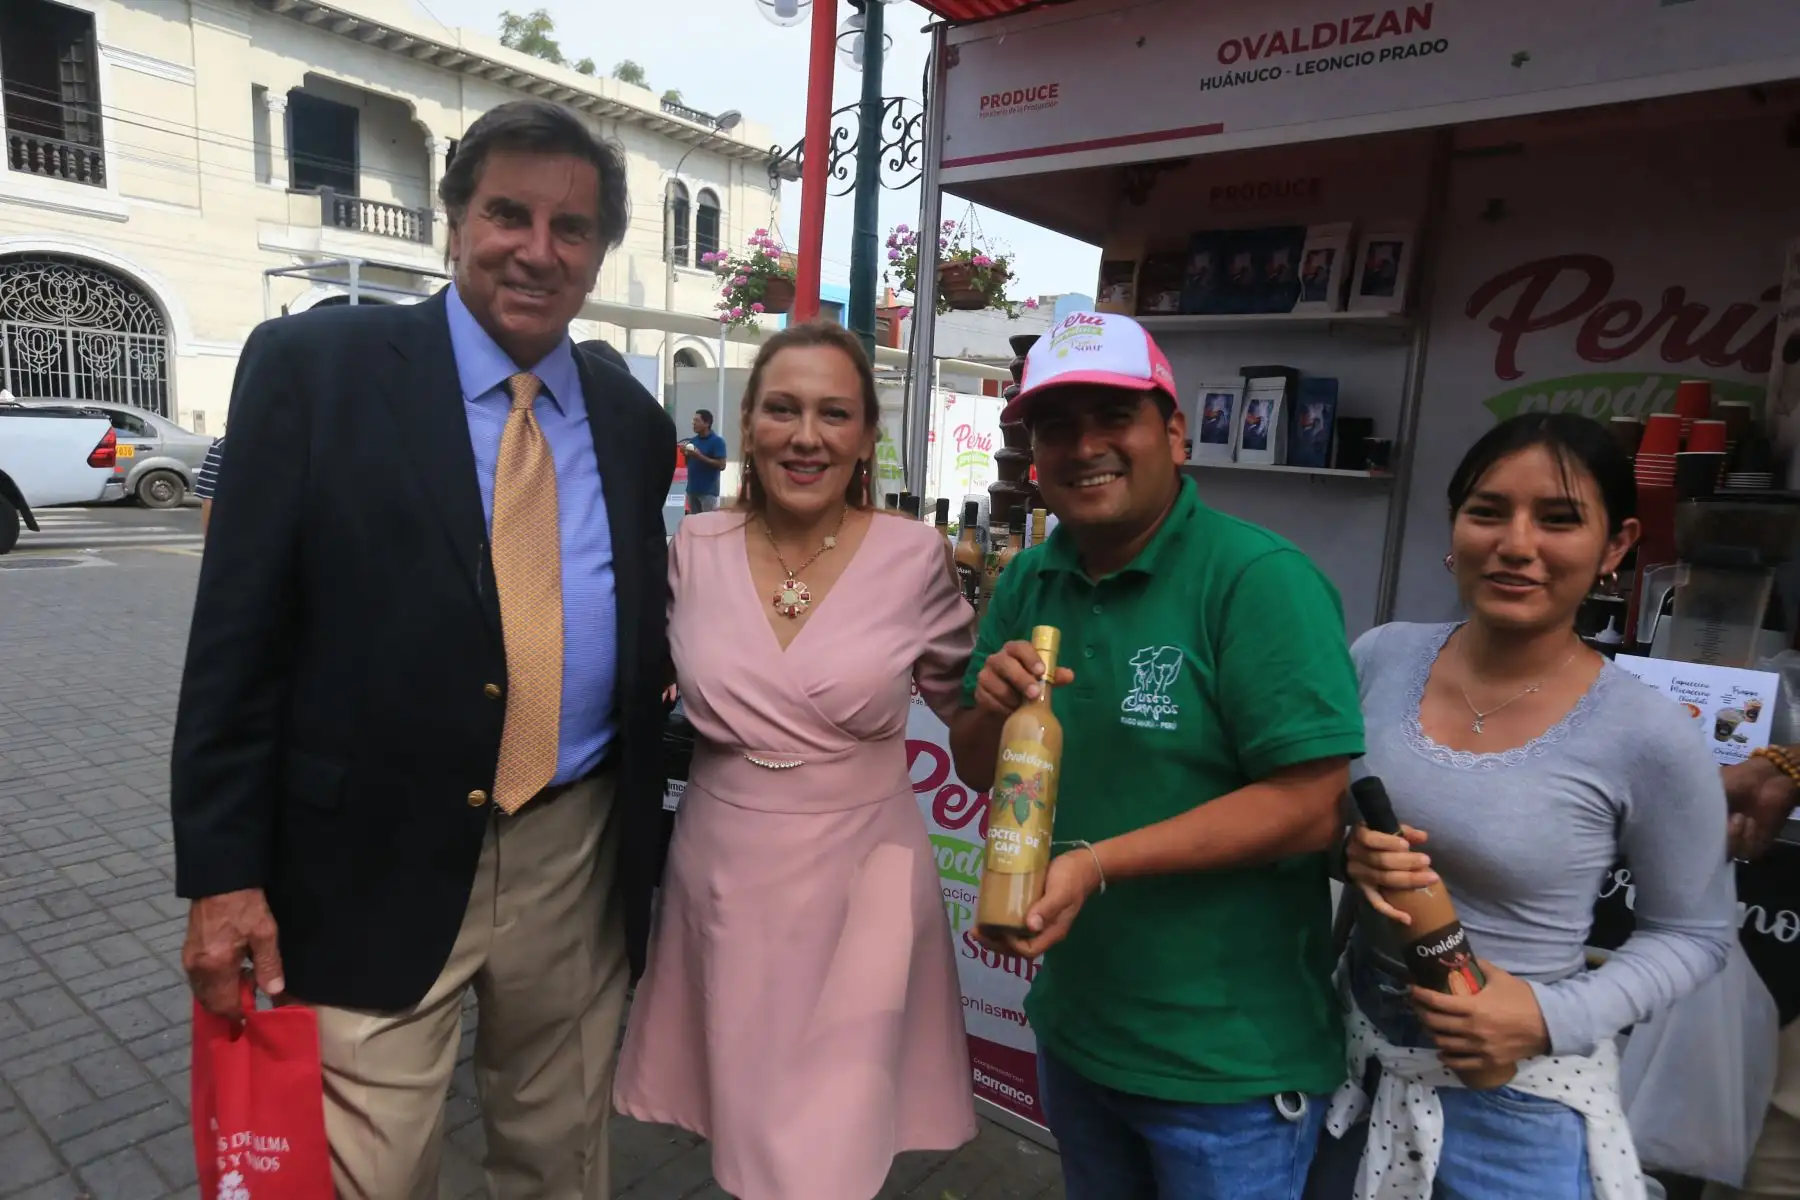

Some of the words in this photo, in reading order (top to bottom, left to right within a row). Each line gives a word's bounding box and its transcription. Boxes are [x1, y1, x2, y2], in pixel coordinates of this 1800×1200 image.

[1217, 3, 1434, 65] OVALDIZAN
[1199, 66, 1282, 91] HUÁNUCO
[1295, 50, 1375, 77] LEONCIO
[1378, 38, 1449, 63] PRADO
[980, 83, 1060, 110] PRODUCE
[1210, 177, 1324, 206] PRODUCE
[1121, 696, 1179, 721] Campos
[1127, 687, 1172, 707] Justo
[973, 1067, 1034, 1105] Barranco
